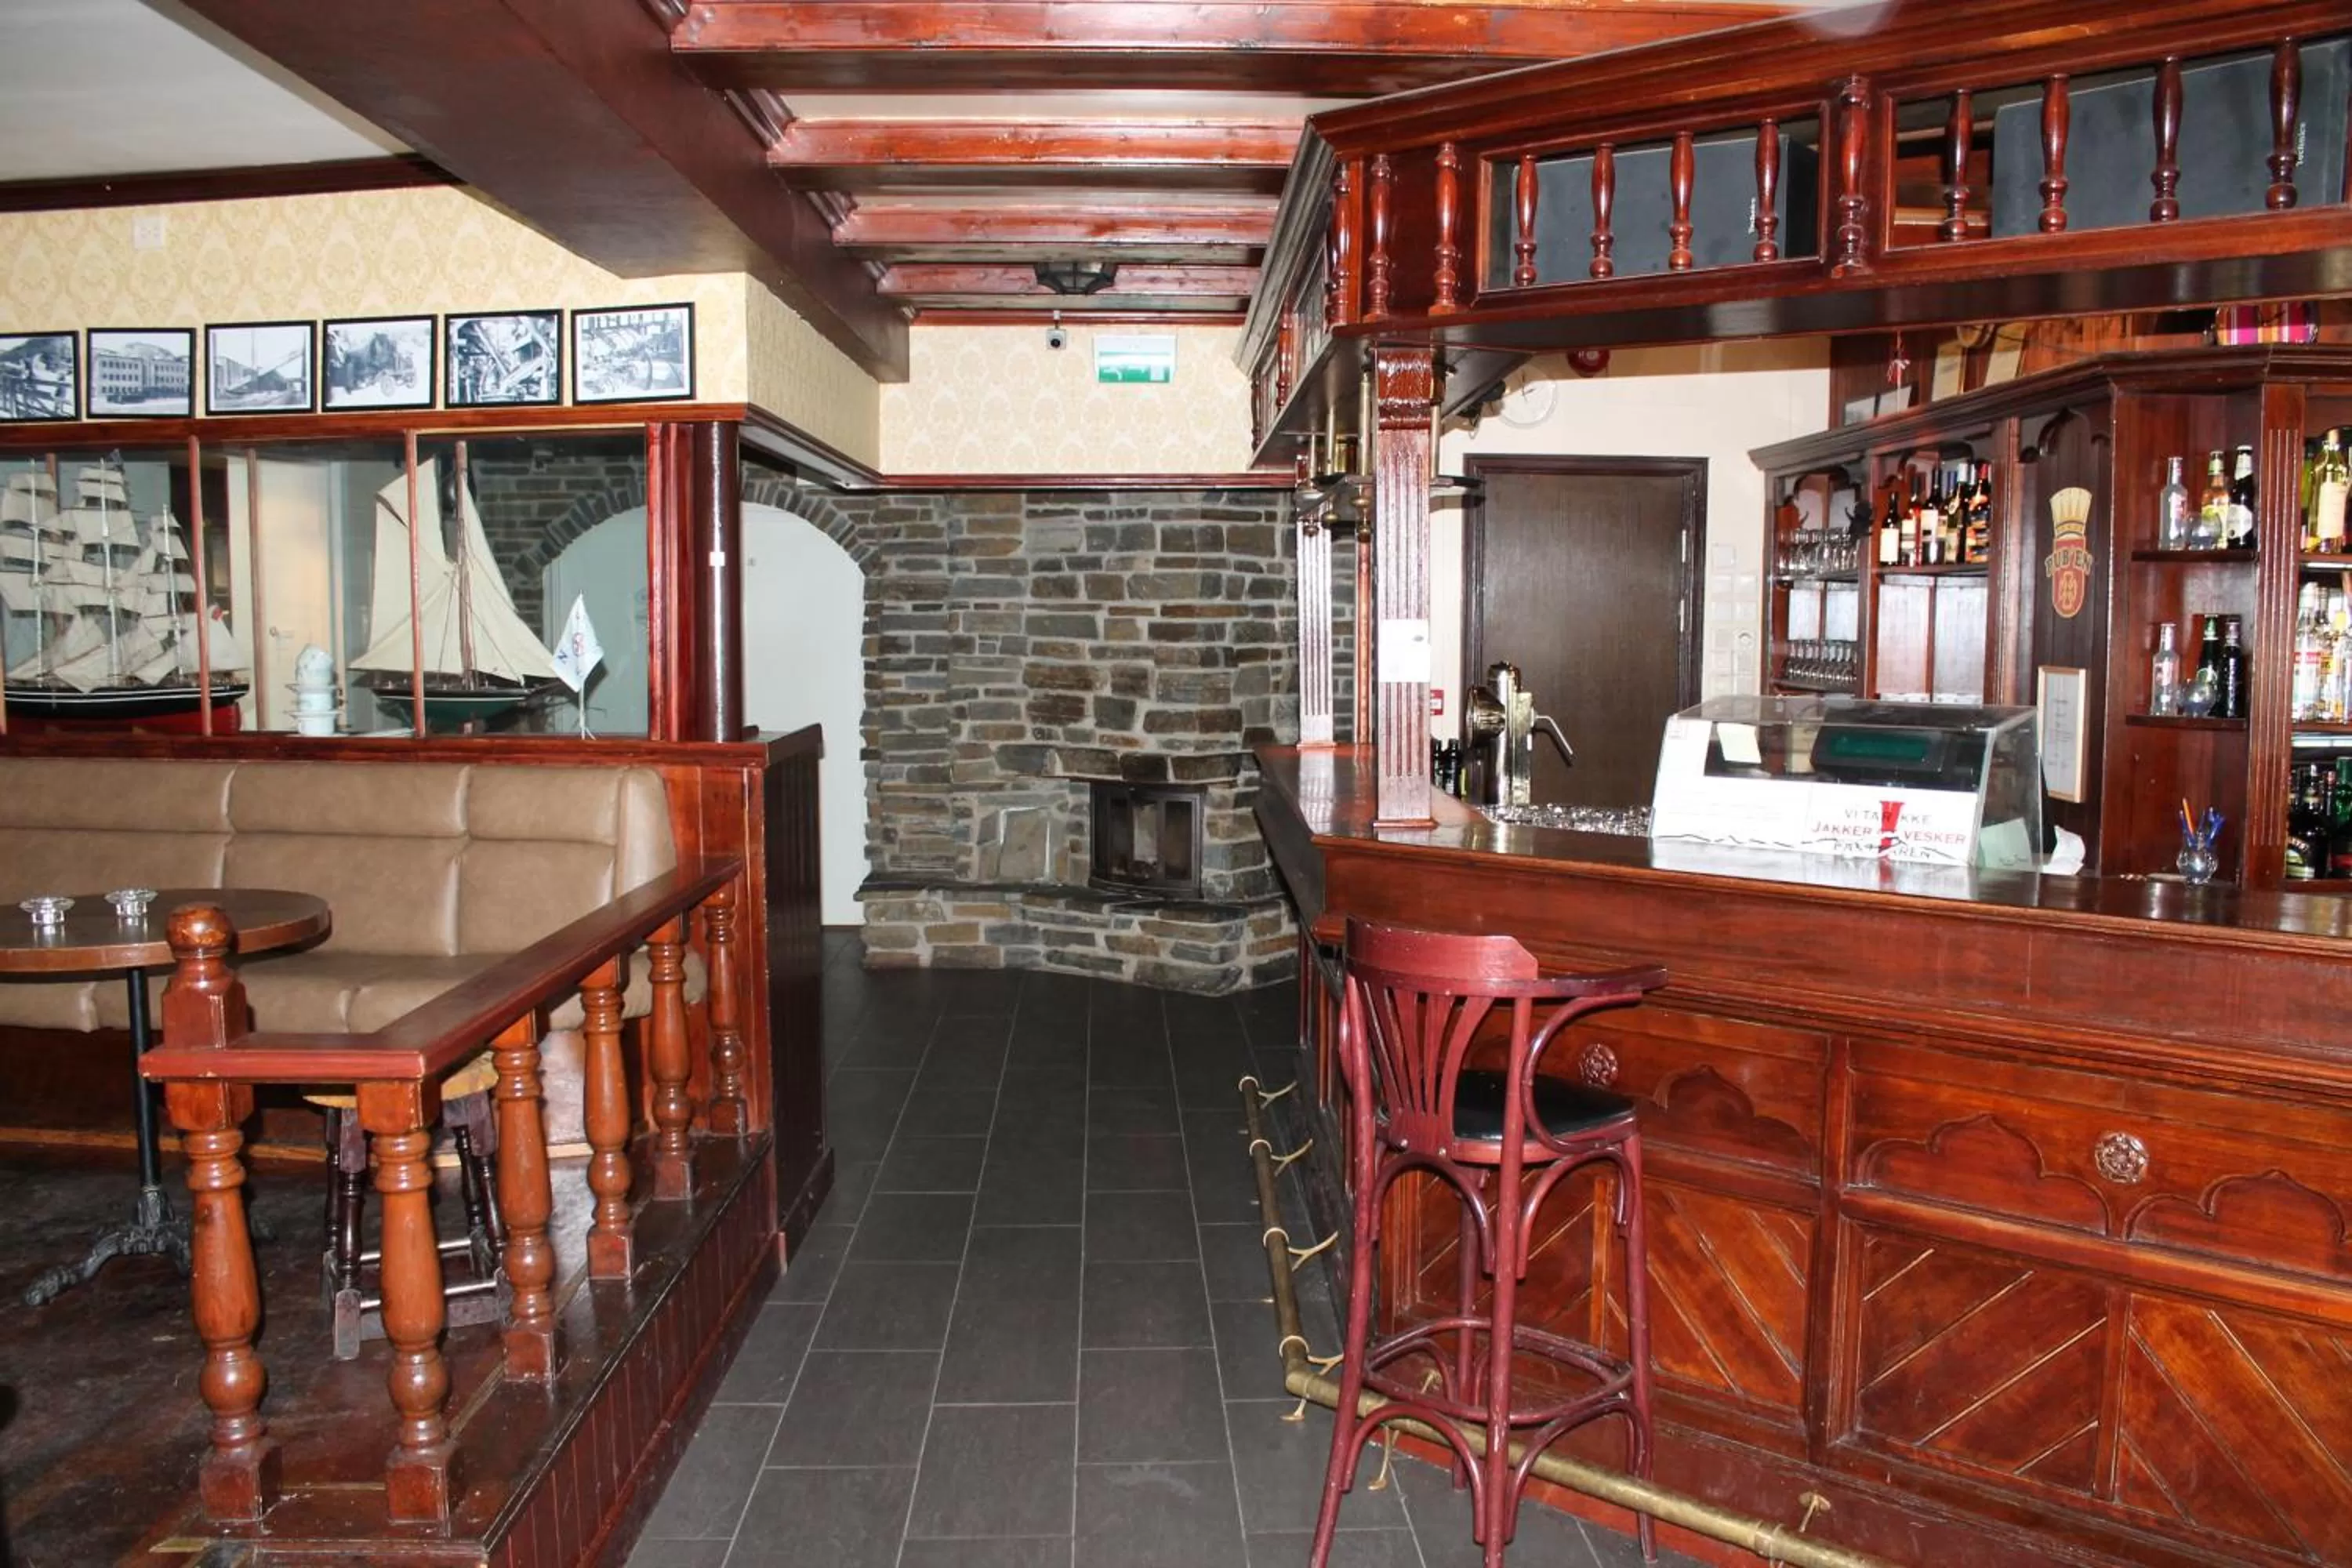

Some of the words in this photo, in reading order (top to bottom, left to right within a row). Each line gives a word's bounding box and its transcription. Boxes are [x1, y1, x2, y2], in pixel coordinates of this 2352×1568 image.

[1844, 808, 1857, 819] VI
[1897, 814, 1933, 825] KKE
[1811, 821, 1872, 837] JAKKER
[1904, 830, 1966, 845] VESKER
